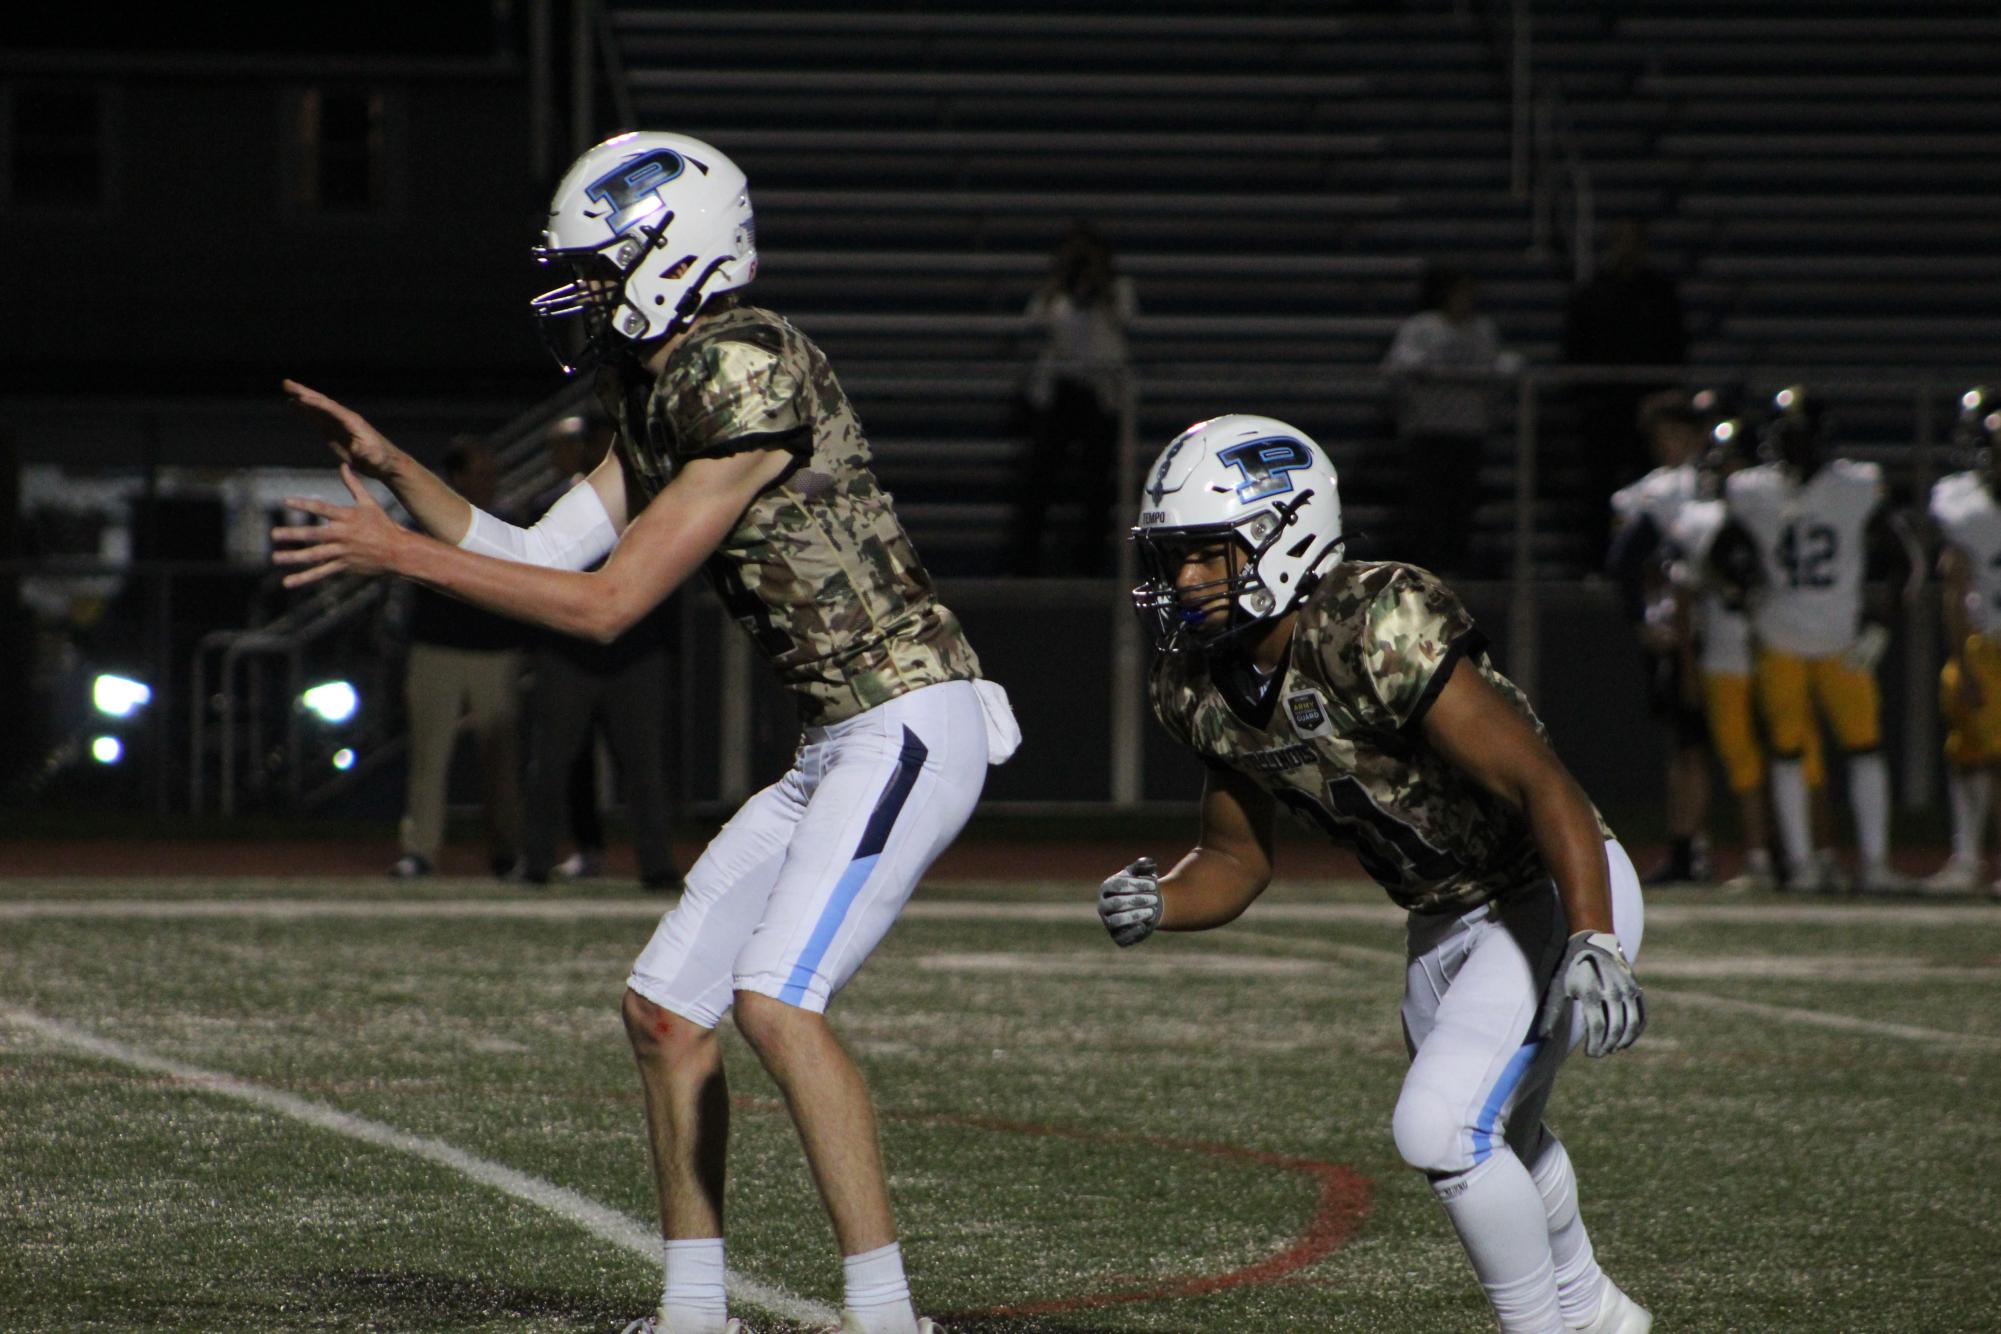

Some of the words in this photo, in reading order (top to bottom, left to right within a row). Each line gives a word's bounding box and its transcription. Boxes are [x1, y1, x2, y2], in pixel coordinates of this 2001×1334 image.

[585, 148, 686, 235] P
[1217, 435, 1313, 505] P
[1142, 511, 1165, 524] TEMPO
[1296, 711, 1320, 722] GUARD
